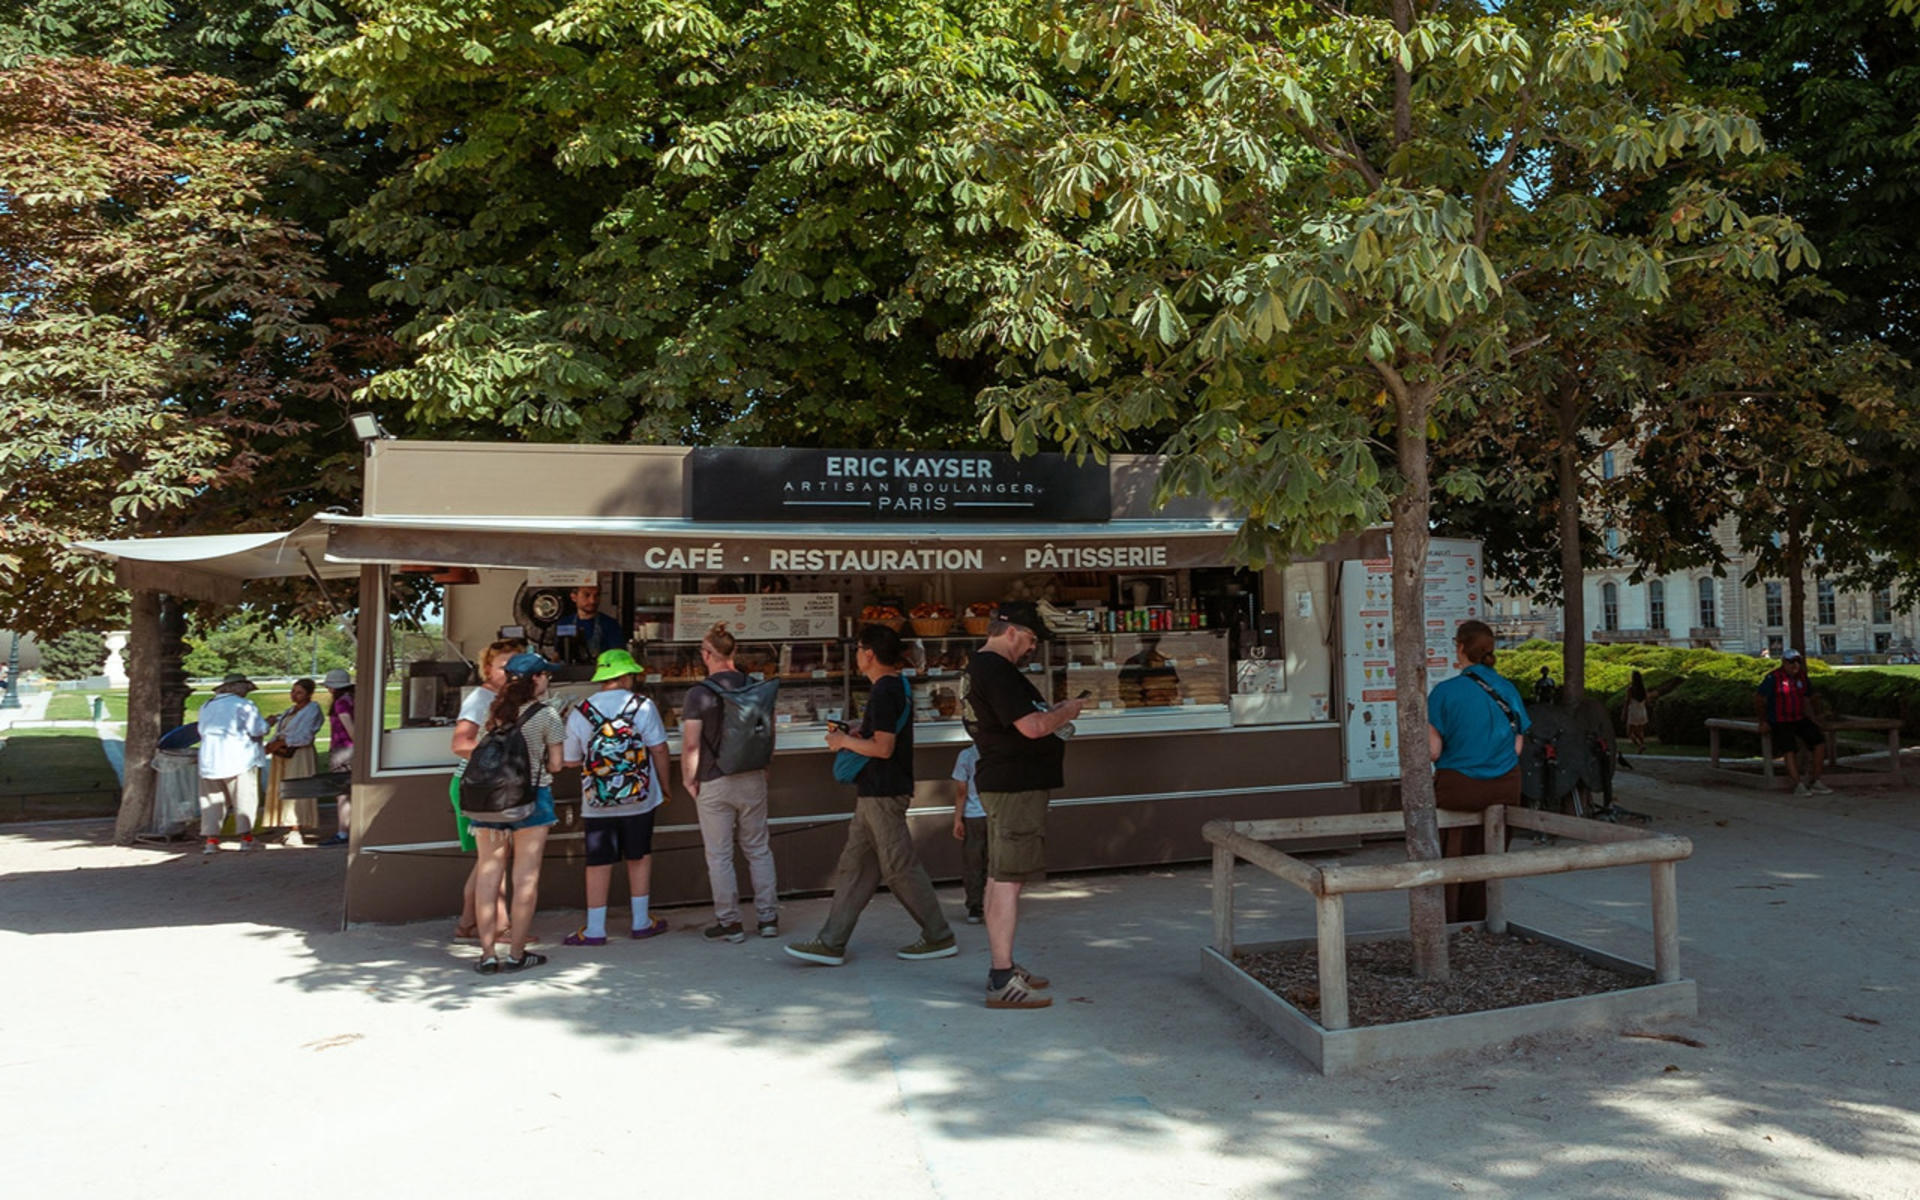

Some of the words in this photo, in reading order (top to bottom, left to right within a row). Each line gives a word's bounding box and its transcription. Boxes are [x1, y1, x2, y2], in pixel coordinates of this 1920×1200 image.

[826, 456, 888, 477] ERIC
[894, 457, 993, 478] KAYSER
[783, 481, 889, 493] ARTISAN
[908, 482, 1034, 494] BOULANGER
[878, 497, 947, 511] PARIS
[644, 542, 724, 570] CAFÉ
[769, 549, 983, 571] RESTAURATION
[1025, 543, 1167, 569] PÂTISSERIE
